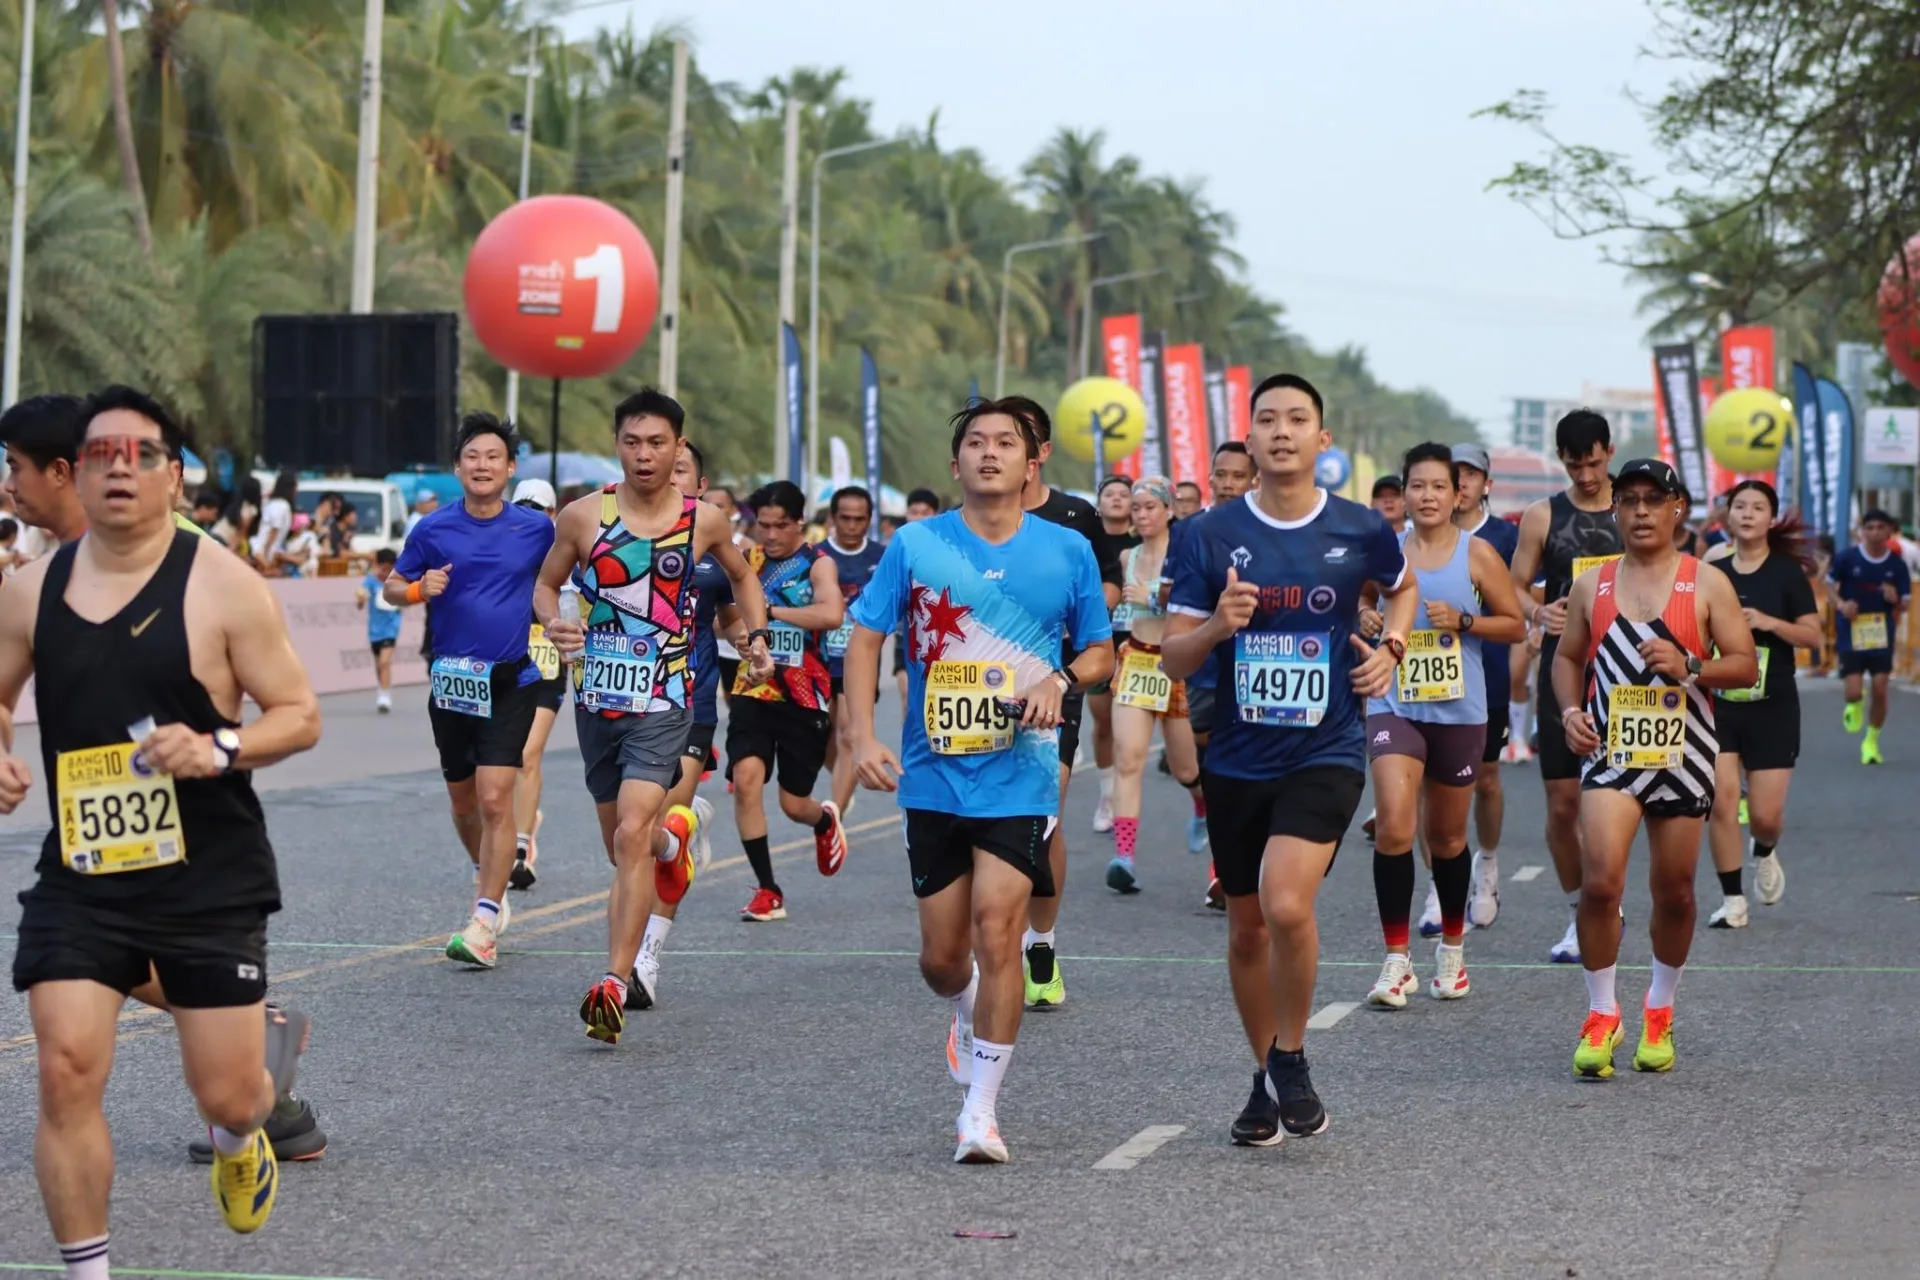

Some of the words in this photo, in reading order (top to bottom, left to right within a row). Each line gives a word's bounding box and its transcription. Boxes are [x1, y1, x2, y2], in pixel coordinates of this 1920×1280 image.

[573, 243, 625, 333] 1
[1101, 402, 1128, 439] 2
[1748, 411, 1776, 450] 2
[982, 569, 1005, 579] Ari
[1283, 585, 1302, 608] 10
[1674, 582, 1695, 592] 02
[593, 633, 615, 645] BANG
[615, 637, 628, 653] 10
[593, 641, 615, 653] SAEN
[1245, 635, 1277, 645] BANG
[1278, 634, 1293, 656] 10
[1245, 645, 1277, 656] SAEN
[1423, 632, 1434, 648] 10
[458, 657, 469, 671] 10
[934, 664, 962, 674] BANG
[963, 665, 977, 684] 10
[1409, 655, 1459, 683] 2185
[593, 660, 651, 694] 21013
[933, 674, 962, 684] SAEN
[1128, 673, 1168, 697] 2100
[1250, 668, 1325, 702] 4970
[441, 675, 489, 702] 2098
[1617, 688, 1643, 698] BANG
[1644, 689, 1657, 707] 10
[1616, 697, 1643, 706] SAEN
[938, 697, 1009, 731] 5049
[1621, 716, 1683, 747] 5682
[67, 752, 104, 769] BANG
[104, 751, 122, 776] 10
[68, 767, 104, 783] SAEN
[79, 788, 176, 841] 5832
